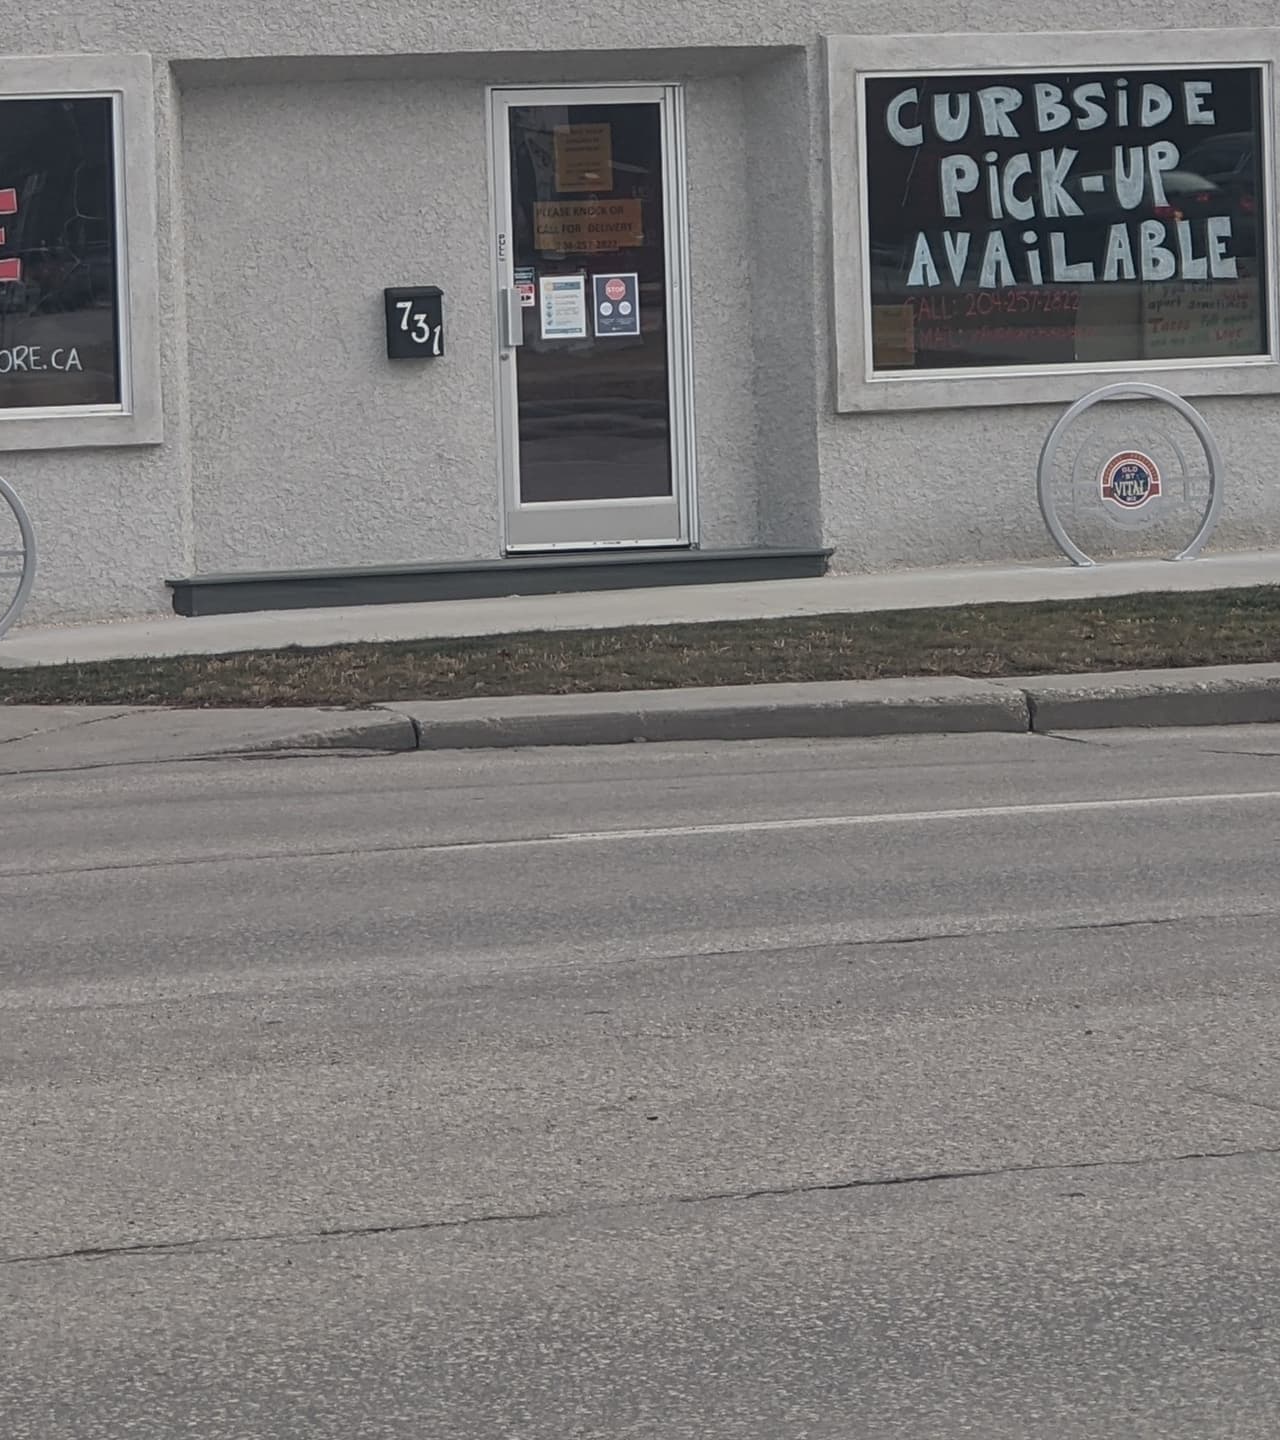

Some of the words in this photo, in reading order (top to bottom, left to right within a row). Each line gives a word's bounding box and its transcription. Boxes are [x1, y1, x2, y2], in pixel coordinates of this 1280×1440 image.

[561, 223, 582, 233] FOR
[587, 222, 633, 233] DELIVERY
[394, 300, 442, 357] 731
[1114, 480, 1146, 496] VITAL
